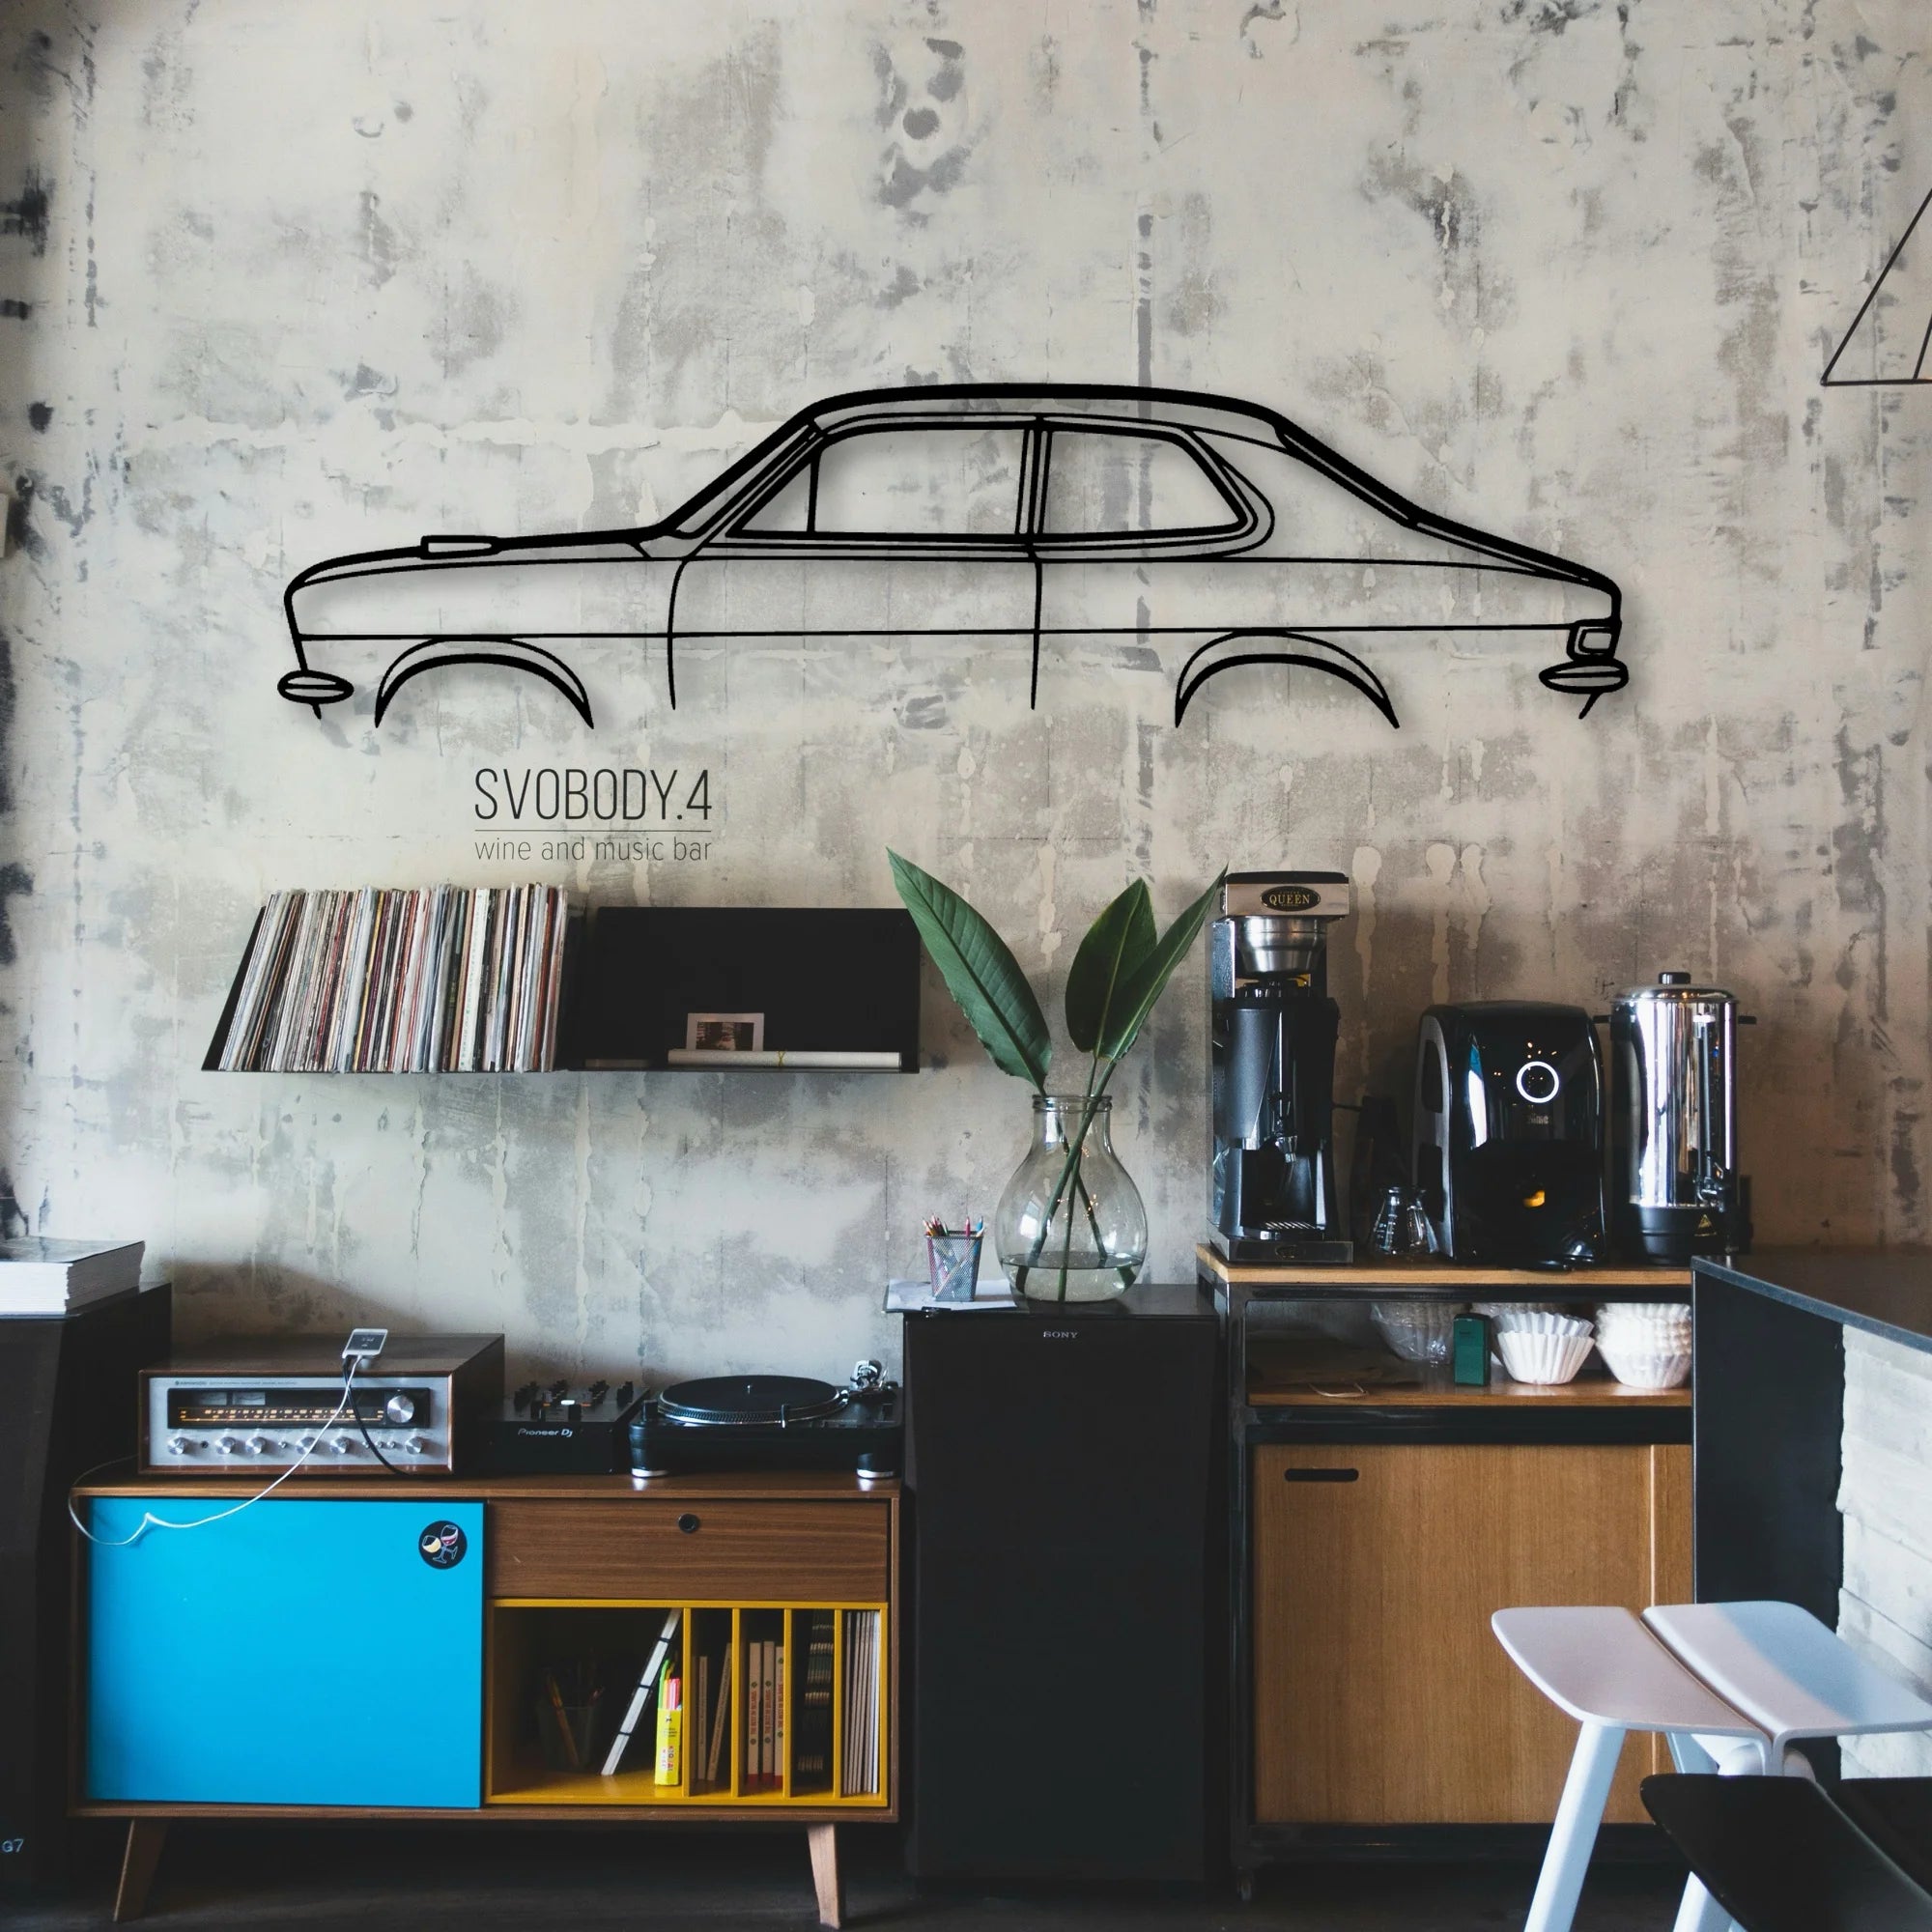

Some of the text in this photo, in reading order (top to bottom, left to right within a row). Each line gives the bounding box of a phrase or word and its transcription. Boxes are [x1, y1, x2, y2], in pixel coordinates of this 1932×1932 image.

[474, 768, 713, 820] SVOBODY.4
[474, 837, 712, 861] wine and music bar
[1269, 895, 1310, 905] QUEEN
[2, 1838, 24, 1853] G7
